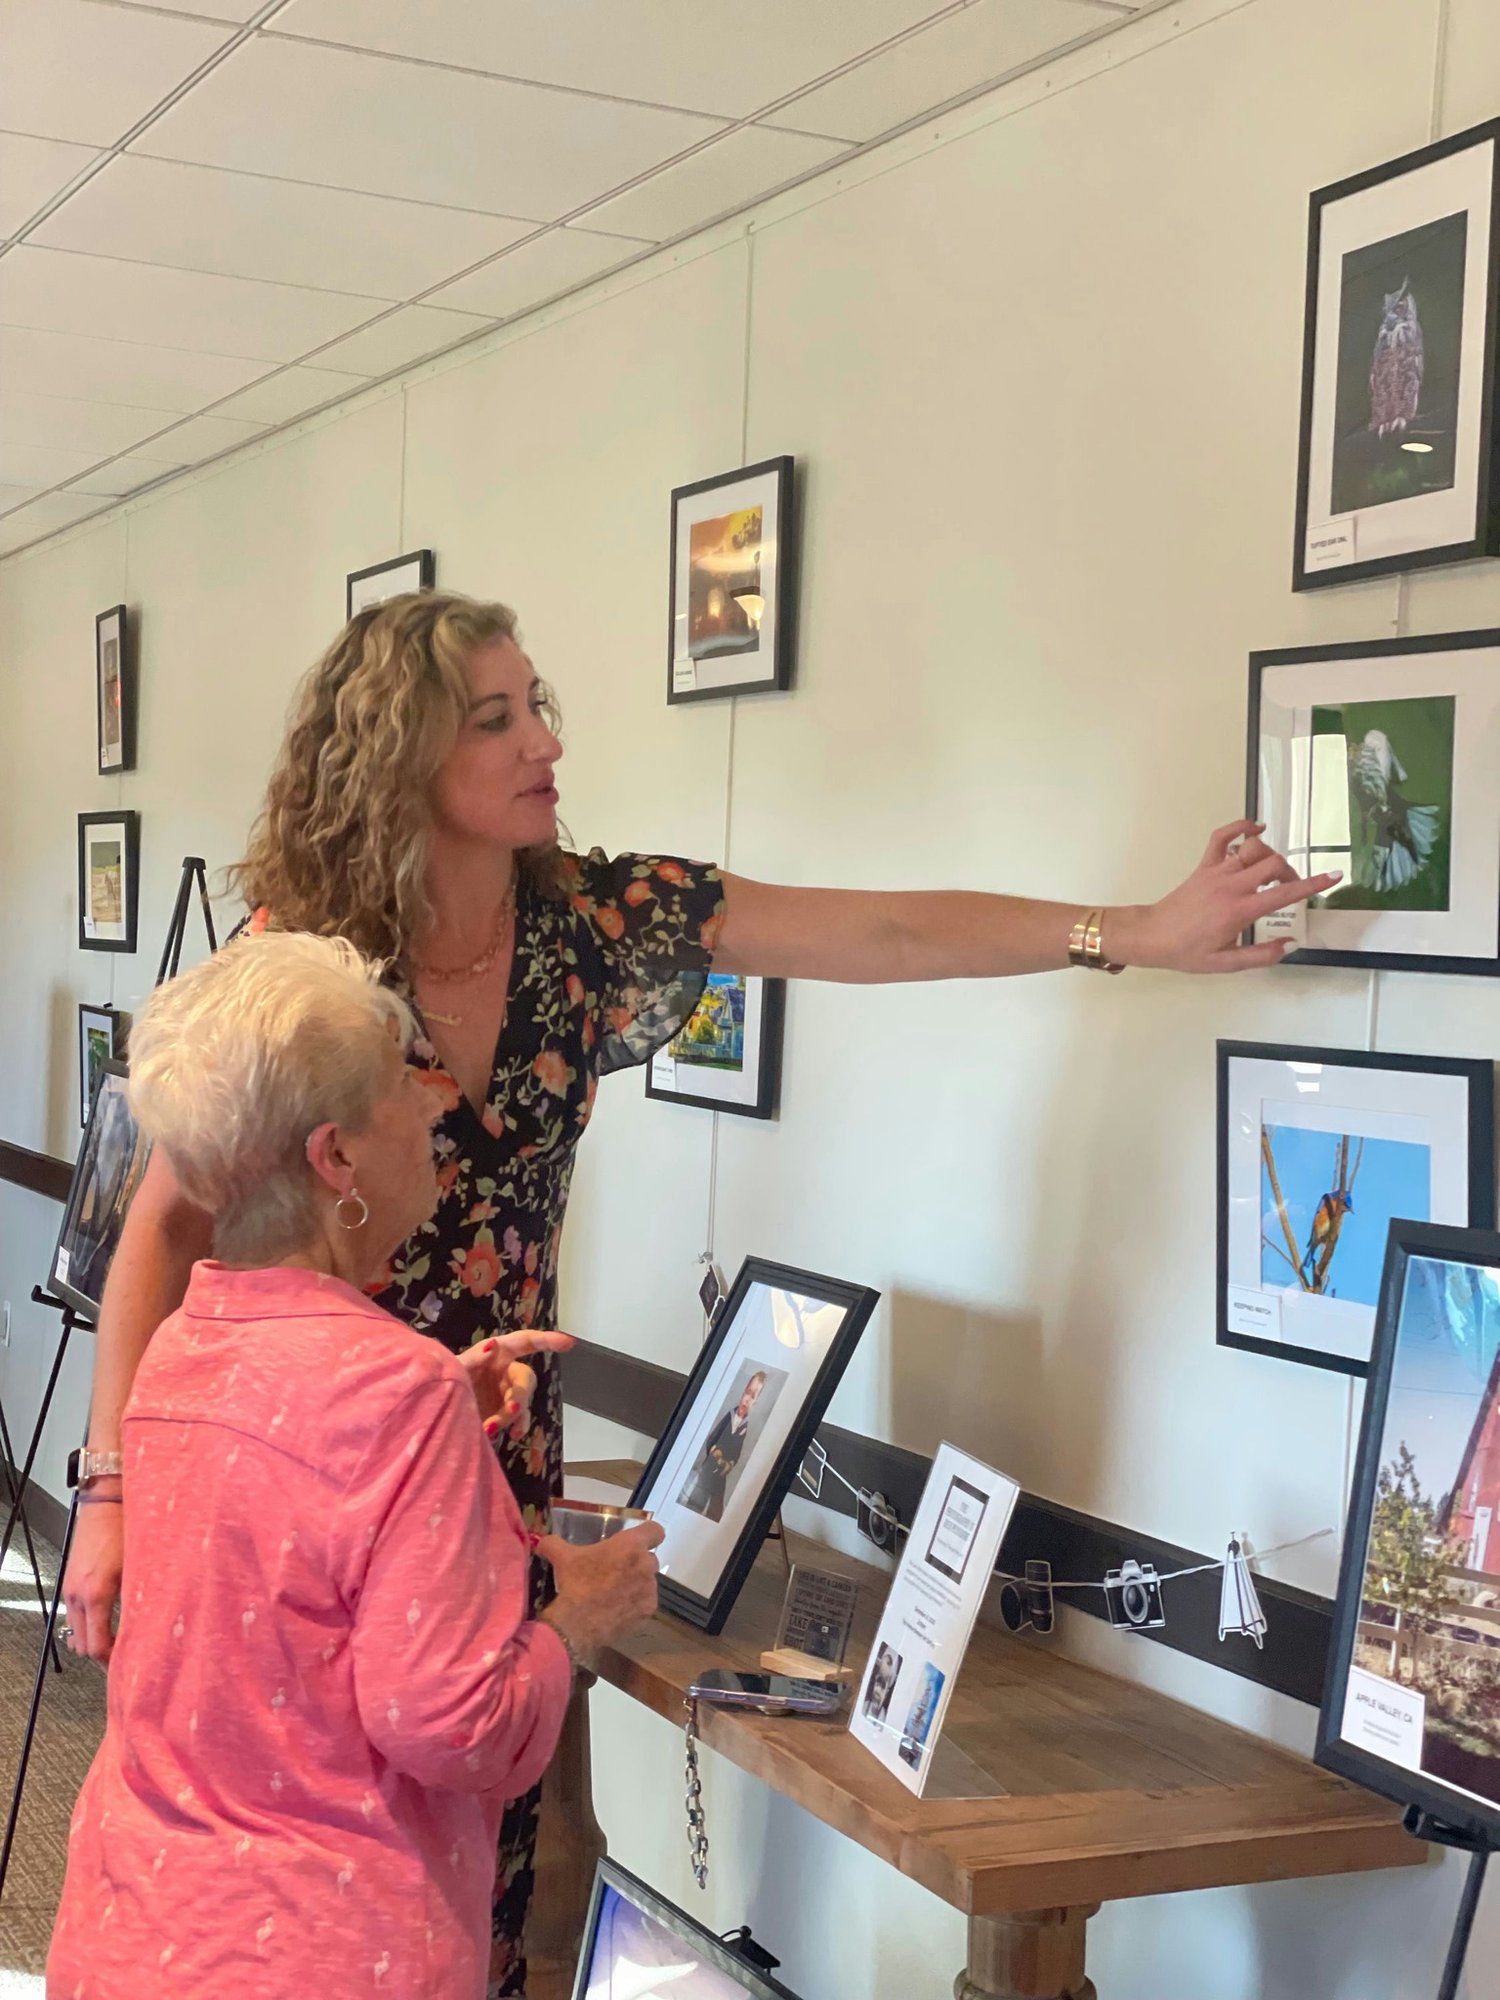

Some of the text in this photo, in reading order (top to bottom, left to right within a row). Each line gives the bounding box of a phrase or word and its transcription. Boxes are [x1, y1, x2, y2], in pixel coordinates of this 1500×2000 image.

[790, 1614, 808, 1629] TAKE
[1356, 1692, 1376, 1708] APPLE
[1404, 1712, 1413, 1724] CA
